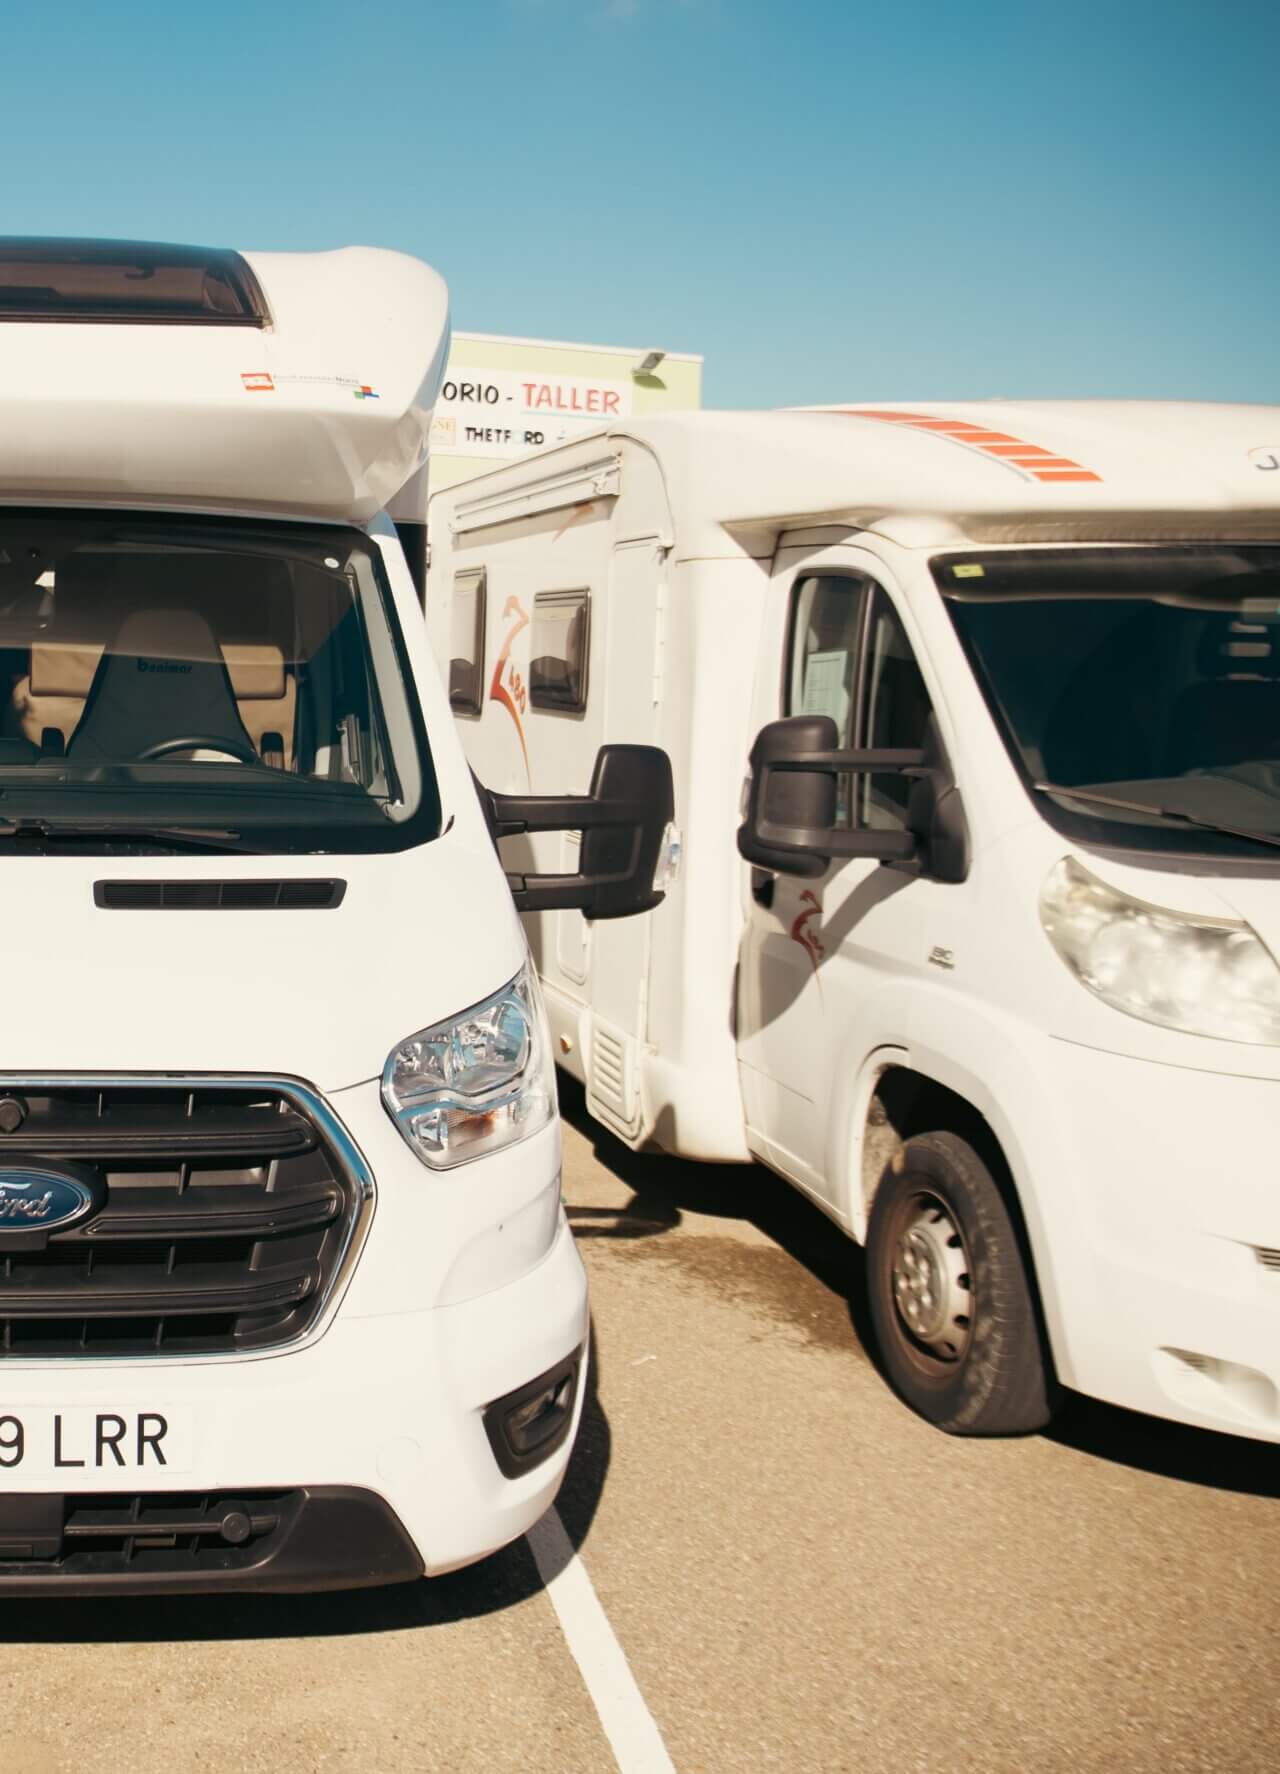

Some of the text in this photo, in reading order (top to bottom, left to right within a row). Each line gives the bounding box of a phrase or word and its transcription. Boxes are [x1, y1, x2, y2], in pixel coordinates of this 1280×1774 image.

[442, 381, 499, 404] ORIO
[522, 383, 620, 415] TALLER
[464, 426, 545, 446] THETFRD
[54, 1413, 168, 1467] LRR
